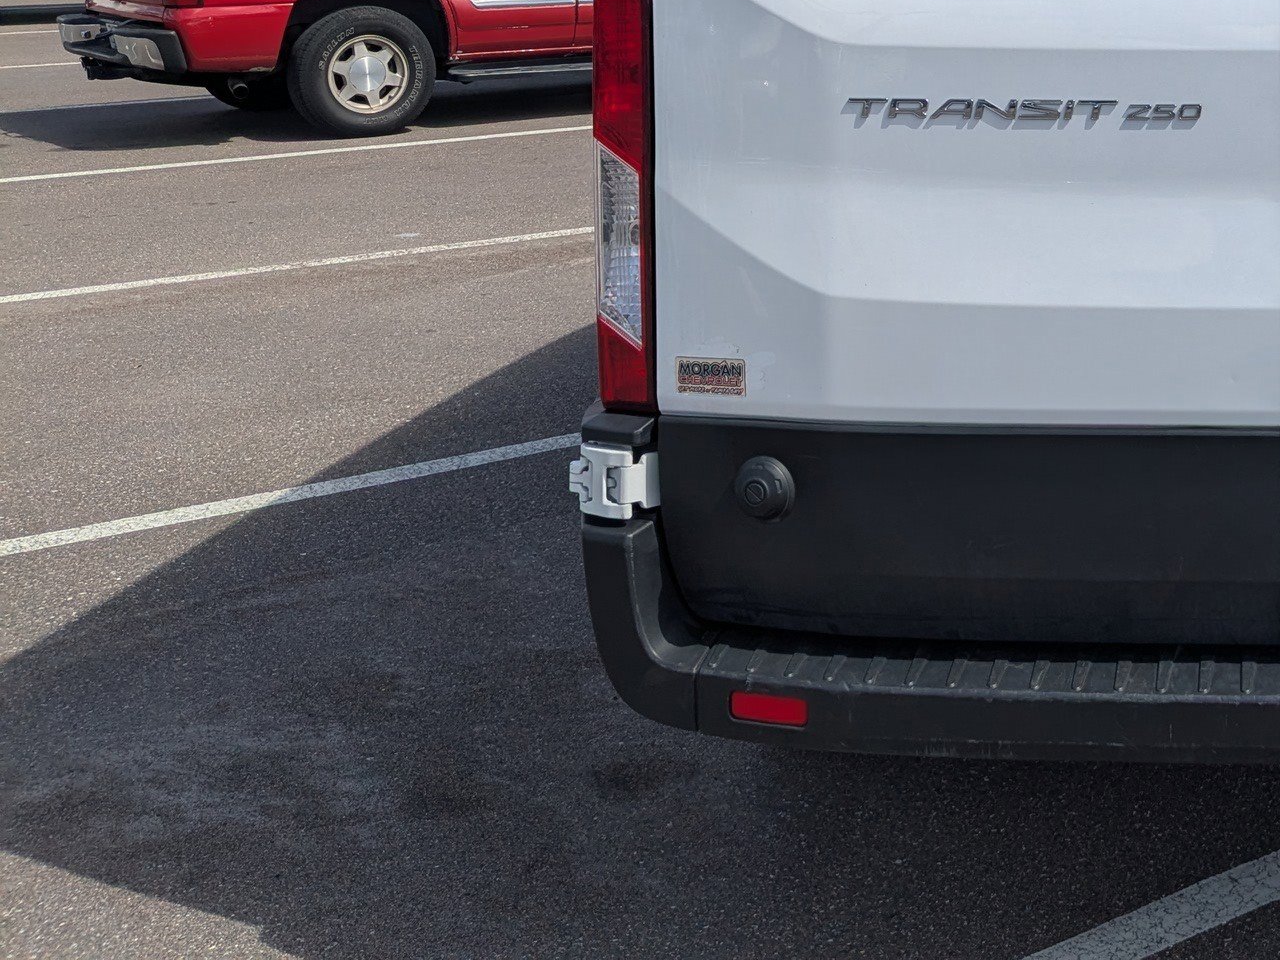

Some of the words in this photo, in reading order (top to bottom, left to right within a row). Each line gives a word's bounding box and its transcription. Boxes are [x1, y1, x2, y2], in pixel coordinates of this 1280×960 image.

[847, 97, 1118, 120] TRANSIT
[1126, 104, 1202, 121] 250
[679, 360, 742, 377] MORGAN
